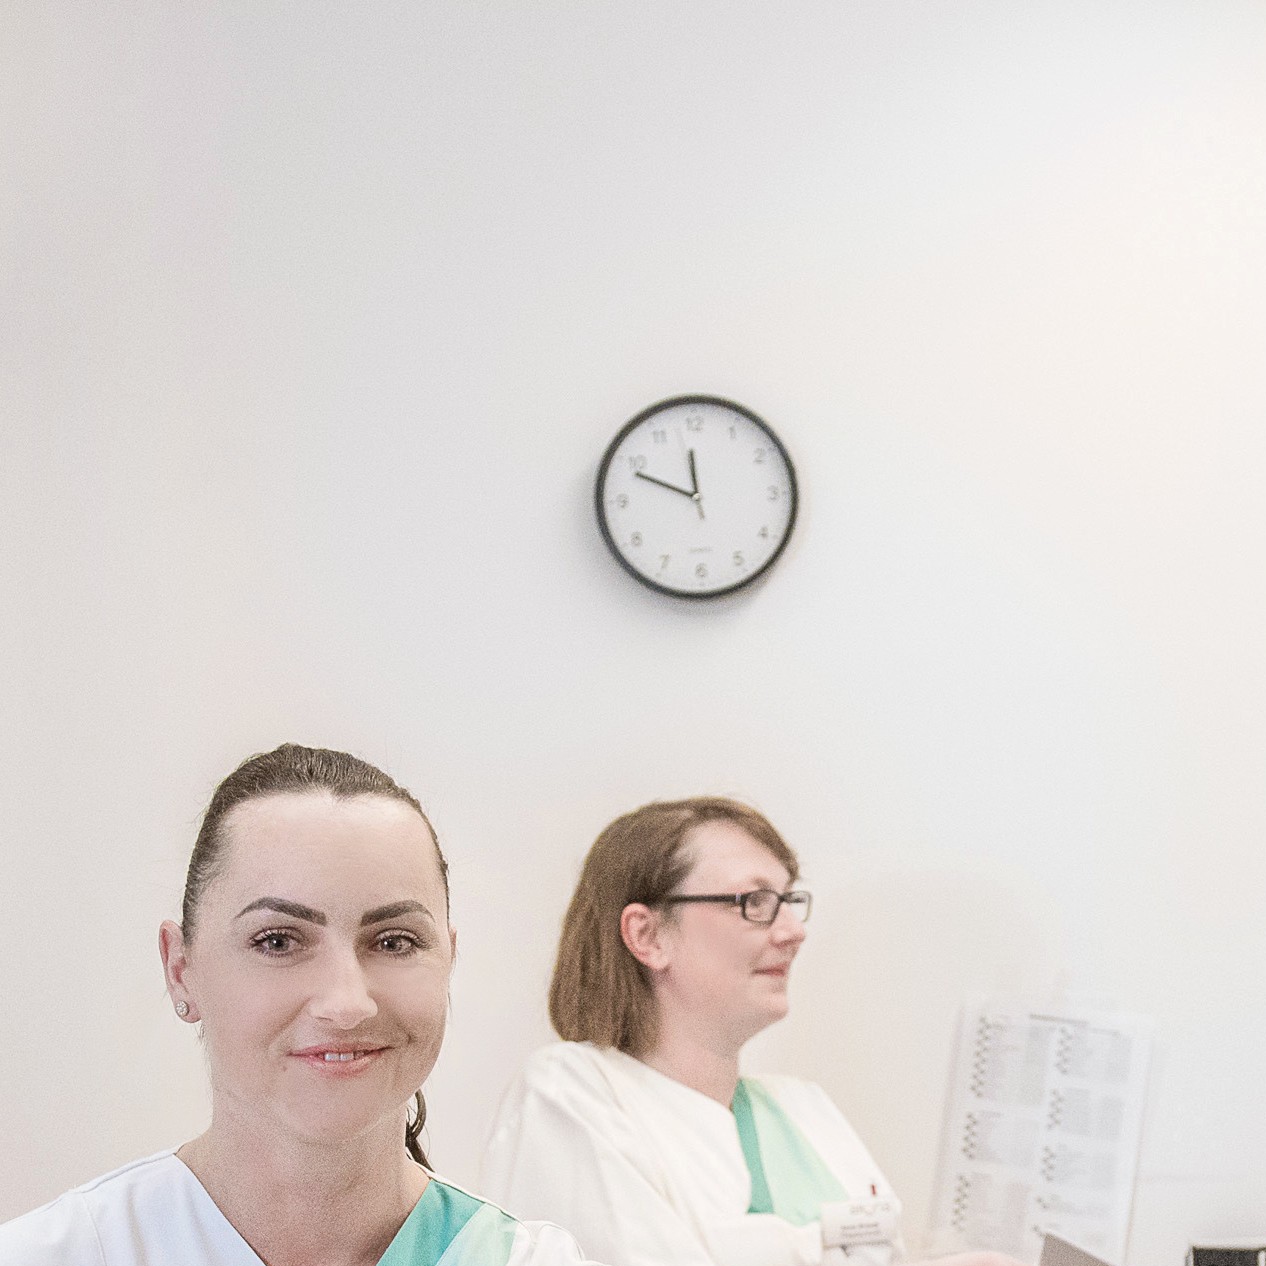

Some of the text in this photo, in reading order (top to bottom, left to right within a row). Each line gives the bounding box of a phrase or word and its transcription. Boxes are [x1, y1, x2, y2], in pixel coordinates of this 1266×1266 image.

[686, 415, 704, 431] 12
[729, 426, 737, 440] 1
[628, 454, 648, 470] 10
[754, 448, 766, 464] 2
[617, 493, 630, 509] 9
[767, 485, 779, 501] 3
[631, 531, 643, 547] 8
[758, 526, 769, 539] 4
[659, 554, 671, 569] 7
[733, 551, 745, 566] 5
[695, 563, 708, 578] 6
